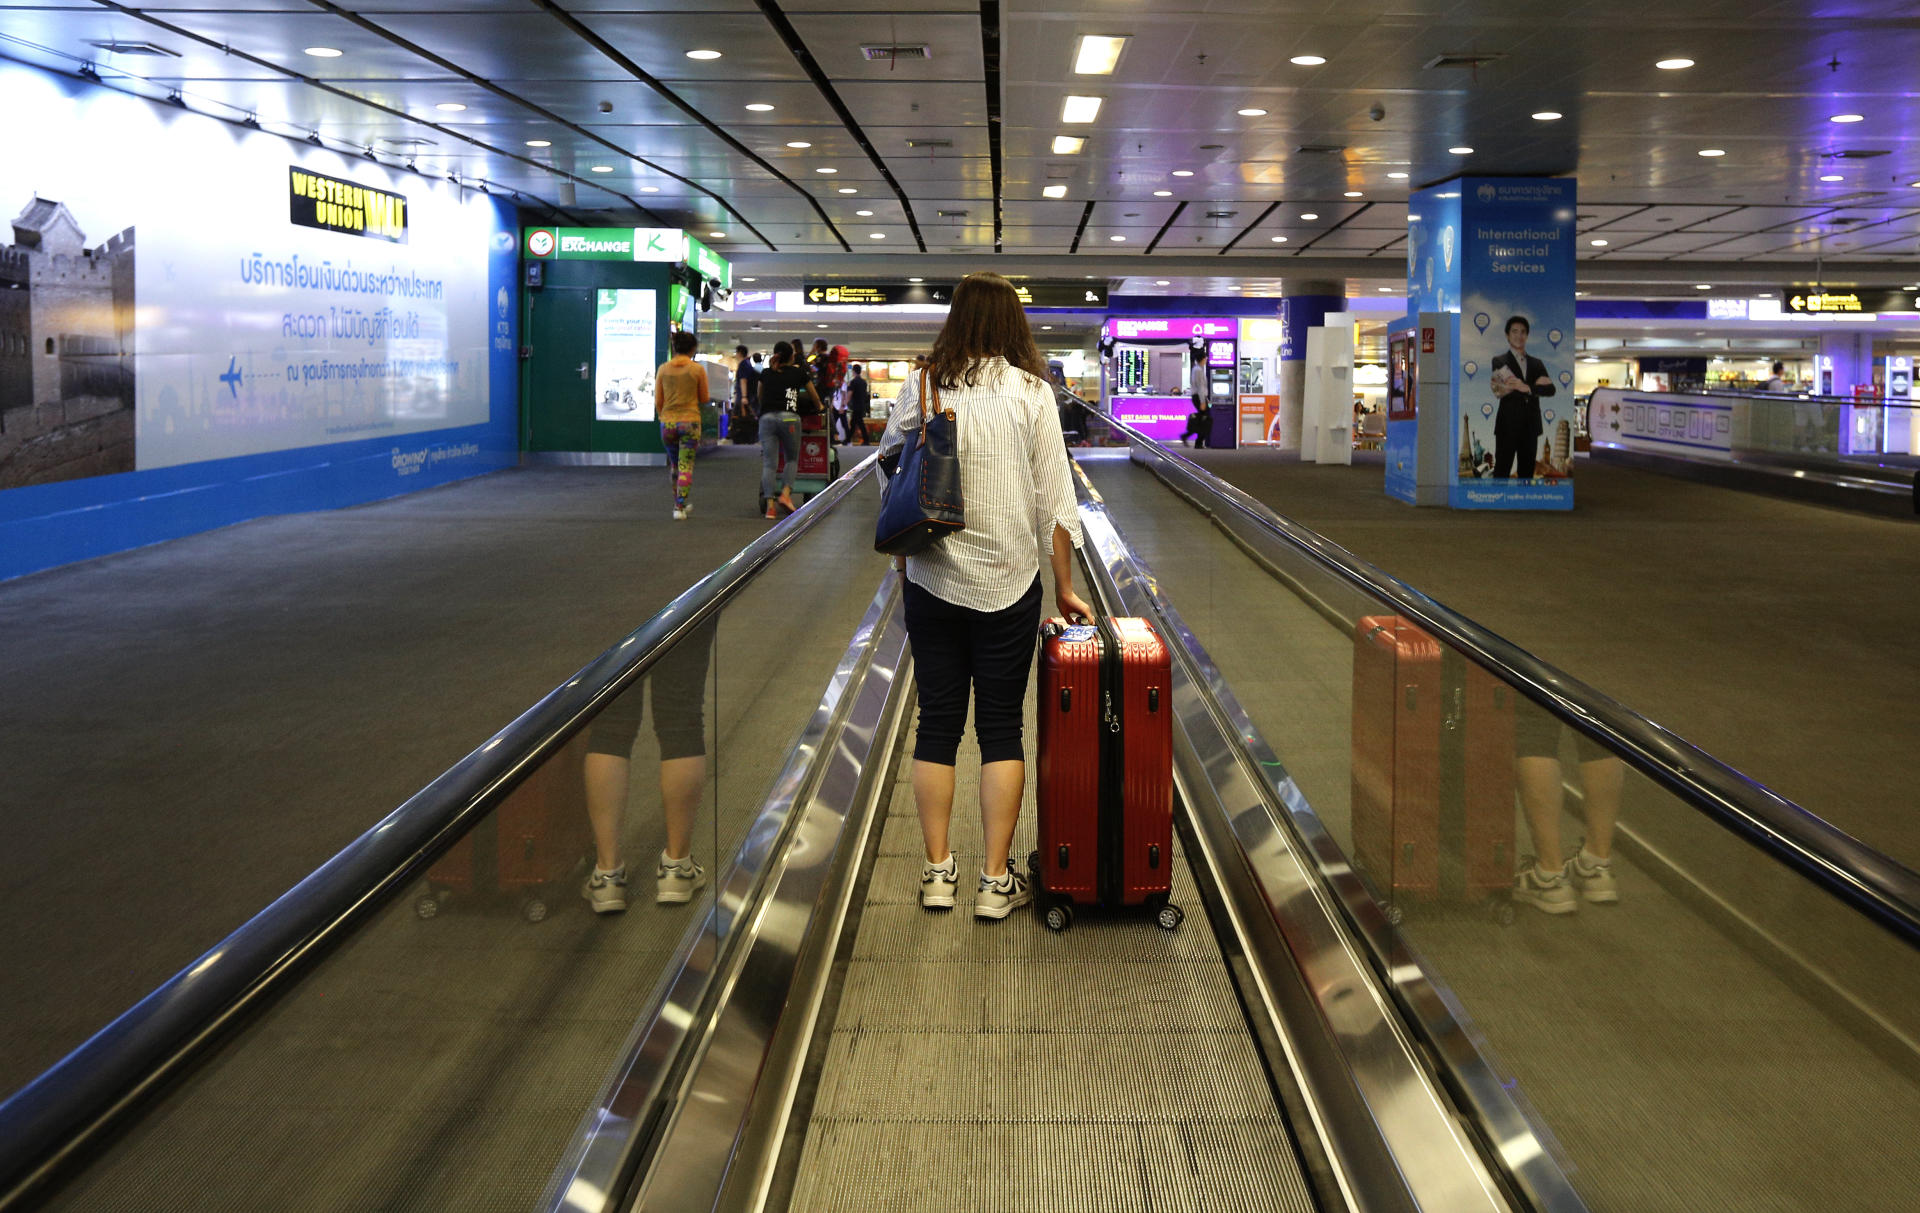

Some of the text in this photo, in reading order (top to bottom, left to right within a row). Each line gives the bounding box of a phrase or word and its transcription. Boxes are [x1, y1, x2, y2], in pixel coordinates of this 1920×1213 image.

[292, 171, 363, 209] WESTERN
[316, 201, 363, 231] UNION
[1478, 228, 1560, 240] International
[561, 239, 630, 252] EXCHANGE
[1489, 244, 1549, 256] Financial
[1492, 261, 1546, 272] Services
[282, 313, 327, 338] สะดวก
